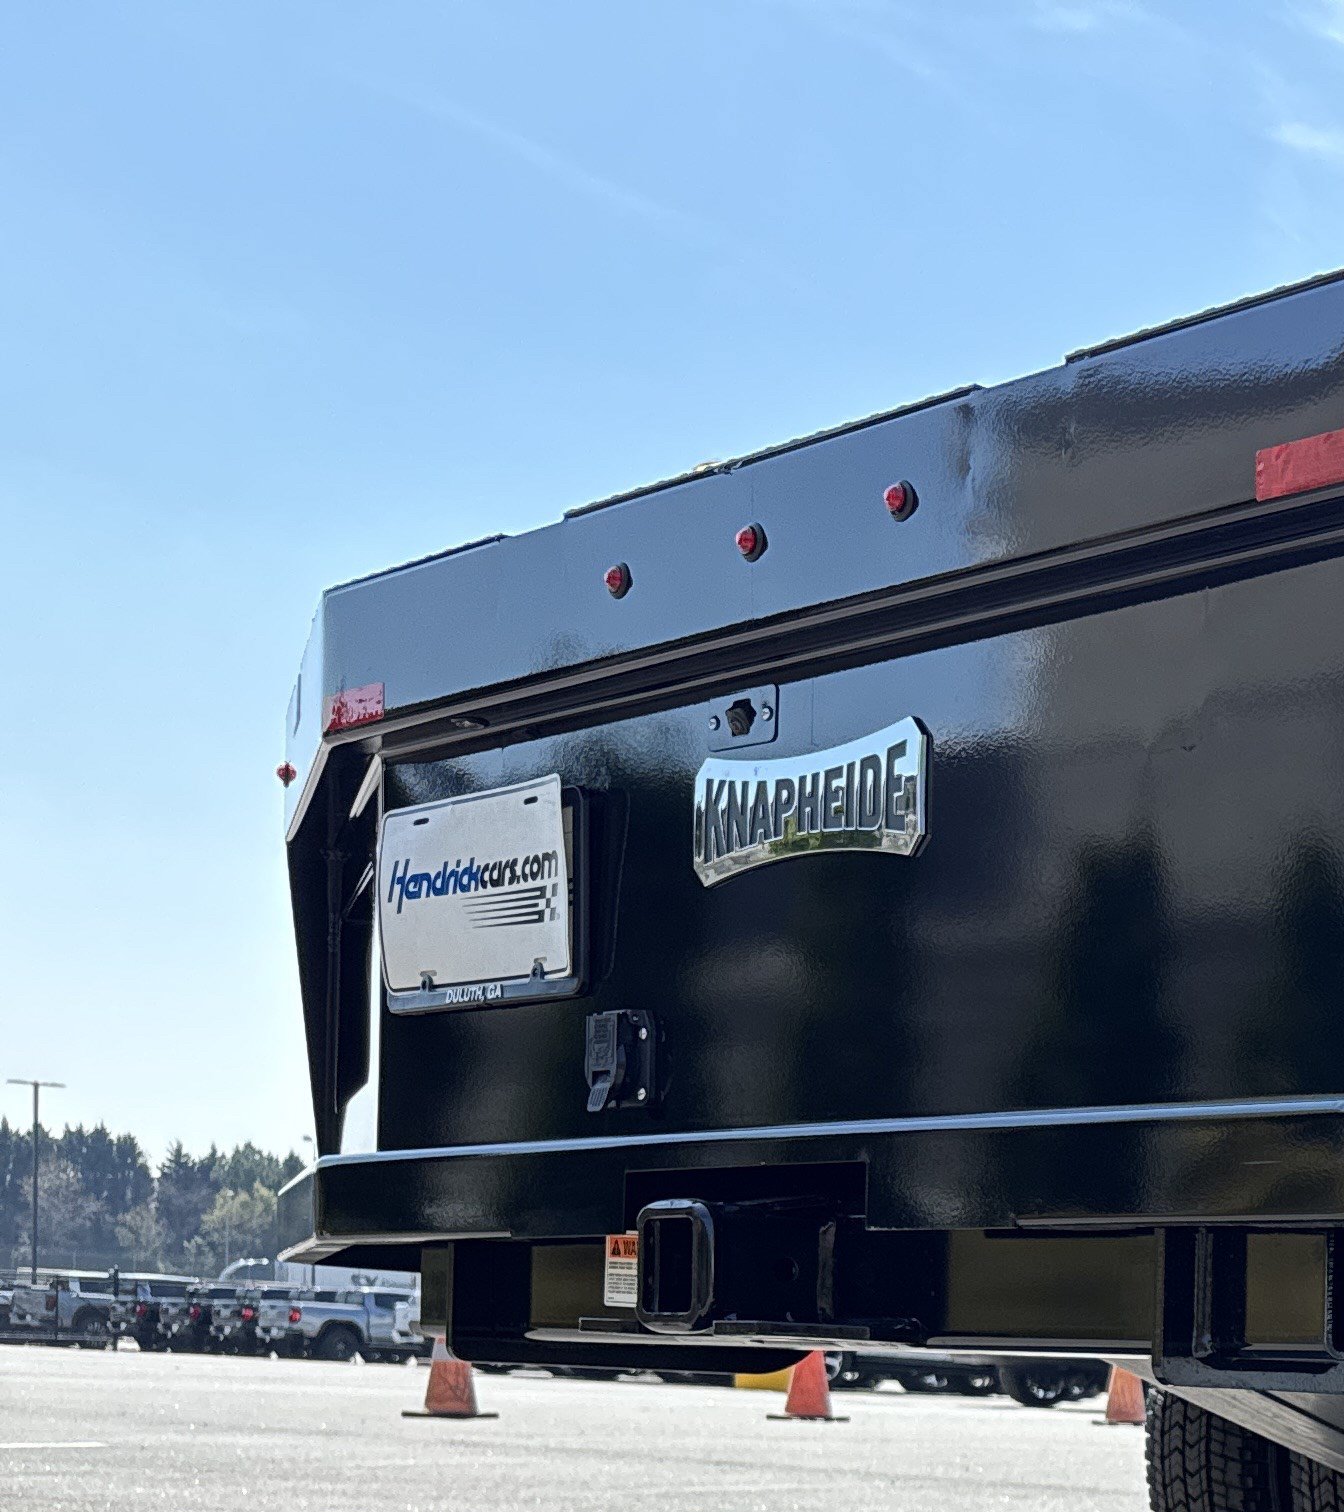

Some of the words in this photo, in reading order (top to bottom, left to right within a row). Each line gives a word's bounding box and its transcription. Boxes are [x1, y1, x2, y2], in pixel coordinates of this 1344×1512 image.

[704, 739, 908, 865] KNAPHEIDE
[387, 850, 559, 914] Hendrickcars.com
[445, 985, 485, 1003] DULUTH,
[486, 983, 503, 1000] GA
